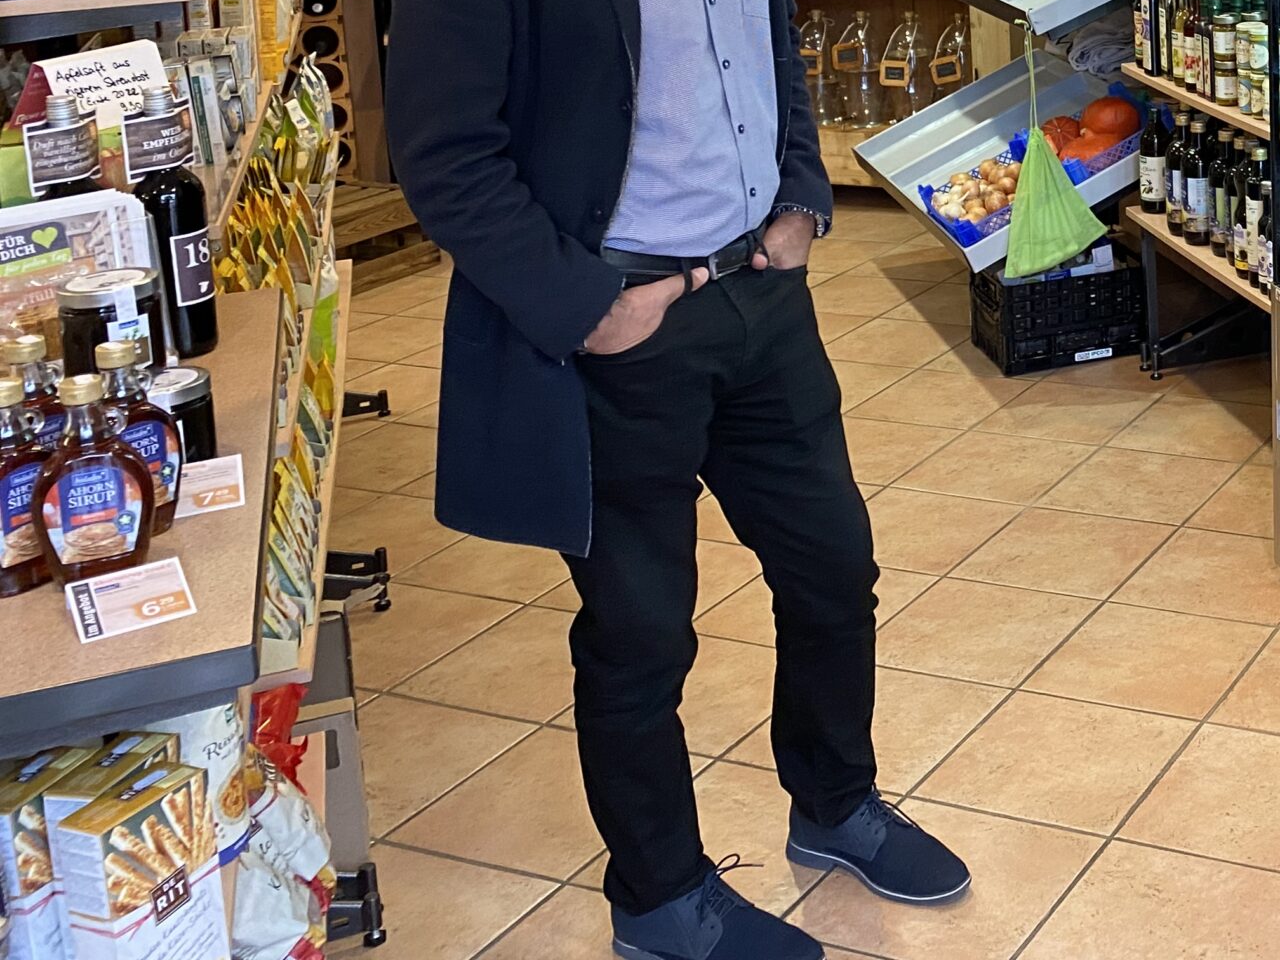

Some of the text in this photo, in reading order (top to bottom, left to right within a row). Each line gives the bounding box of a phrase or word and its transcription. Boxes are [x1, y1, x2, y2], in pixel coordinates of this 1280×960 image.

[56, 61, 106, 82] Apfelsaft
[0, 243, 37, 262] DICH
[67, 481, 115, 499] AHORN
[68, 490, 116, 509] SIRUP
[199, 493, 213, 506] 7
[78, 594, 98, 626] Angebot
[141, 600, 161, 617] 6
[156, 879, 185, 913] RIT
